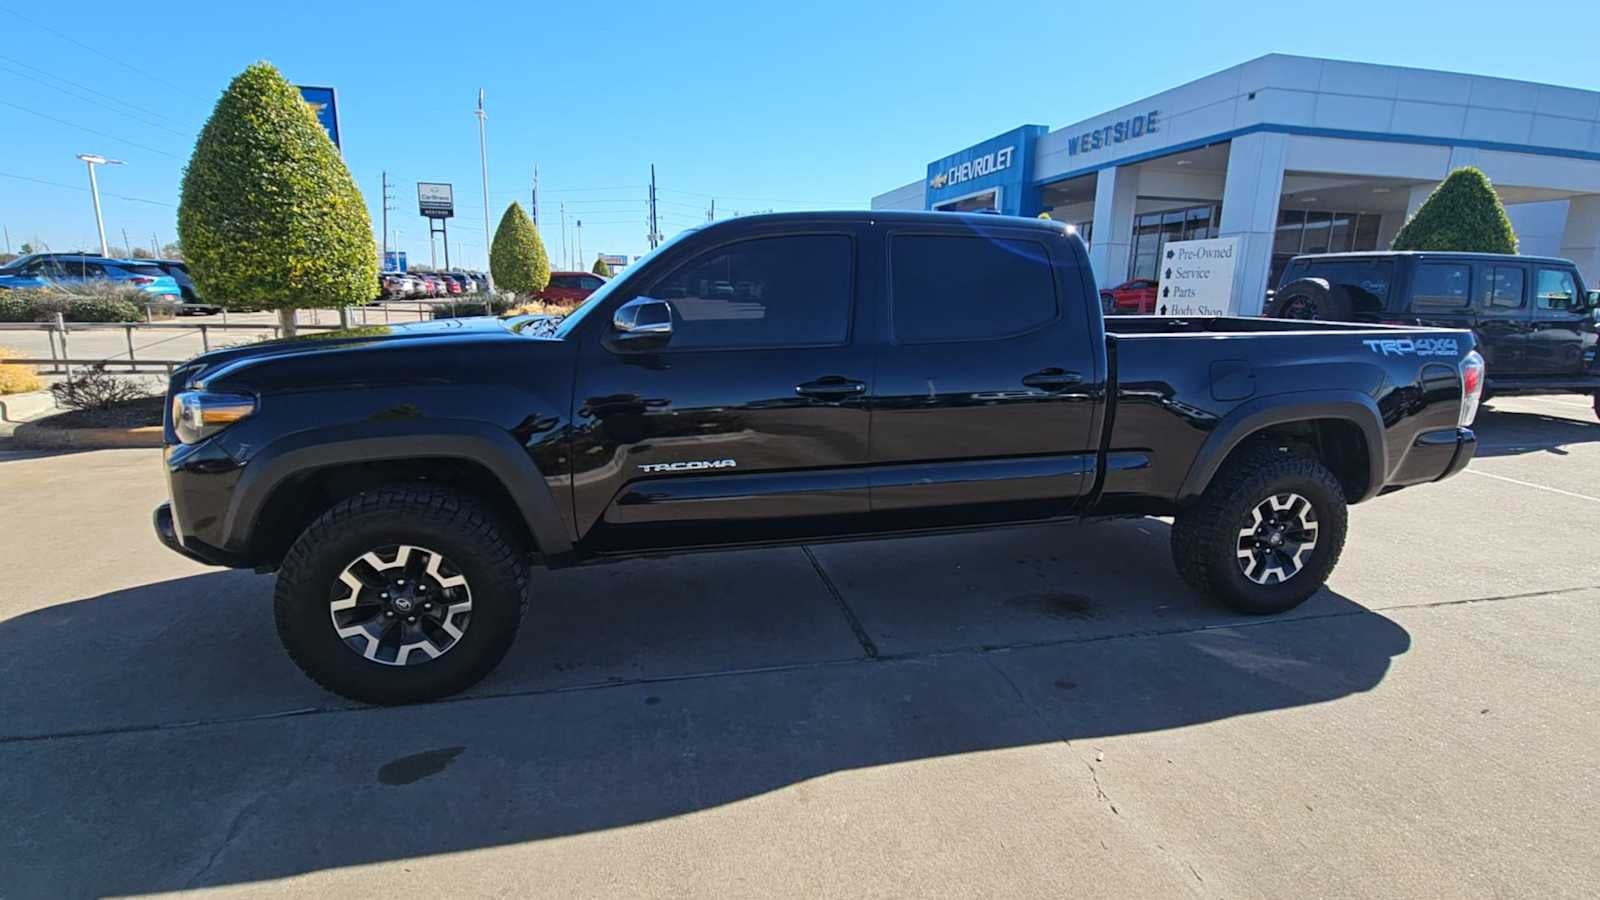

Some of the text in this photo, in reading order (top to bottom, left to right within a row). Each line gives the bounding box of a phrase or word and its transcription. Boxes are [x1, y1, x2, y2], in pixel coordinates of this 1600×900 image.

[1068, 110, 1160, 156] WESTSIDE
[948, 146, 1014, 186] CHEVROLET
[1178, 245, 1232, 260] Pre-Owned
[1175, 266, 1210, 279] Service
[1173, 286, 1196, 298] Parts
[638, 459, 737, 472] TACOMA
